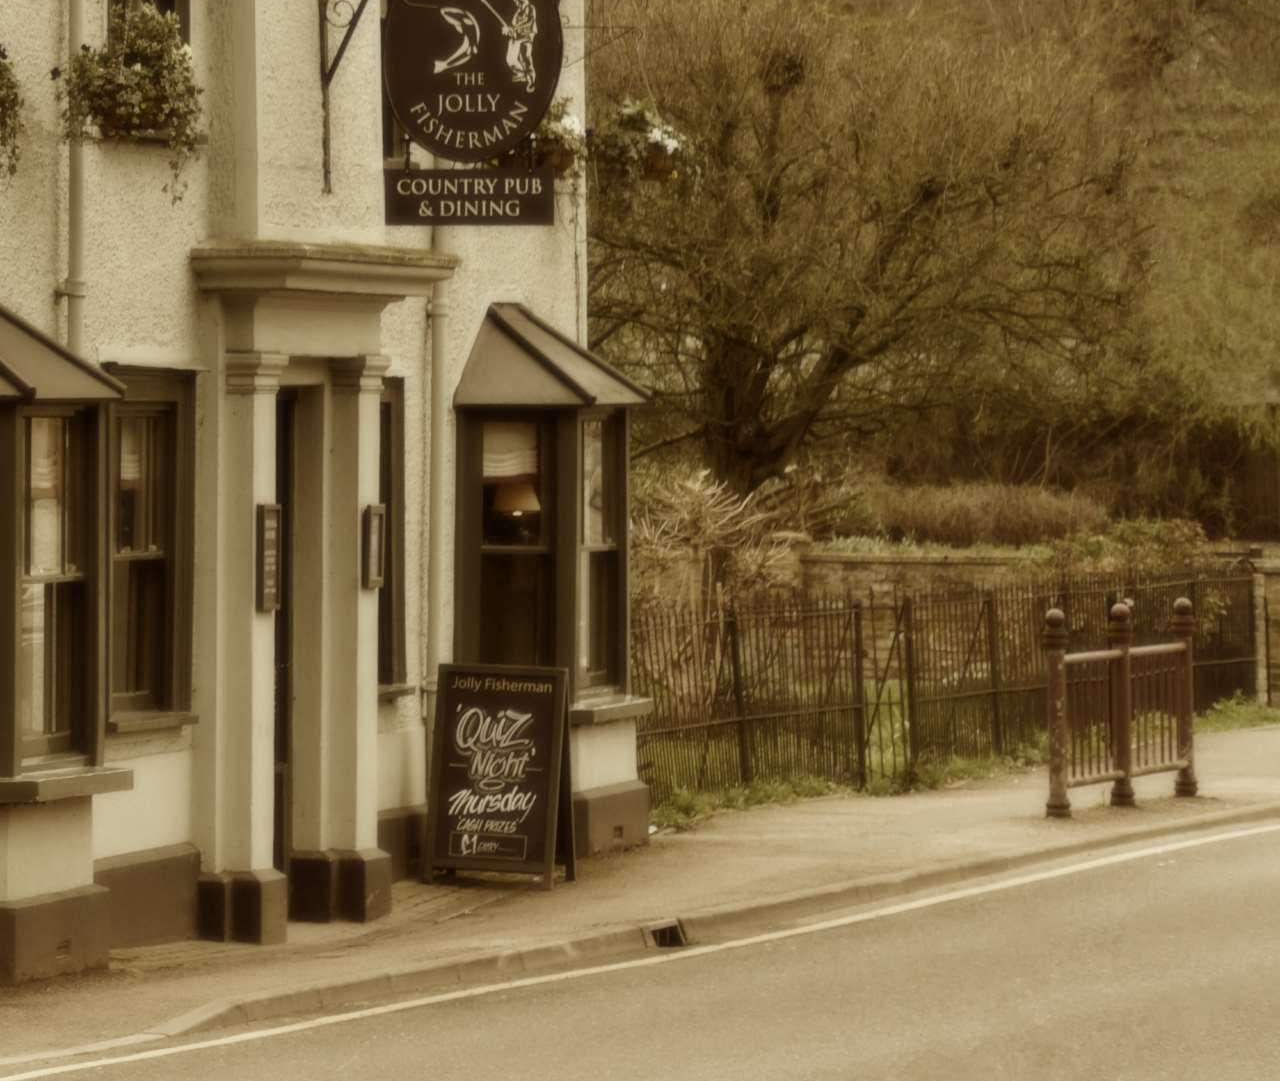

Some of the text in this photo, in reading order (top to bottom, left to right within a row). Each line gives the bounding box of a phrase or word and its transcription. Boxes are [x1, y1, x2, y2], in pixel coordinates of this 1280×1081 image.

[454, 72, 485, 86] THE
[438, 94, 500, 116] JOLLY
[410, 101, 528, 149] FISHERMAN
[397, 178, 542, 195] COUNTRY PUB
[419, 200, 520, 216] & DINING
[451, 676, 552, 695] Jolly Fisherman
[448, 786, 536, 823] Thursday
